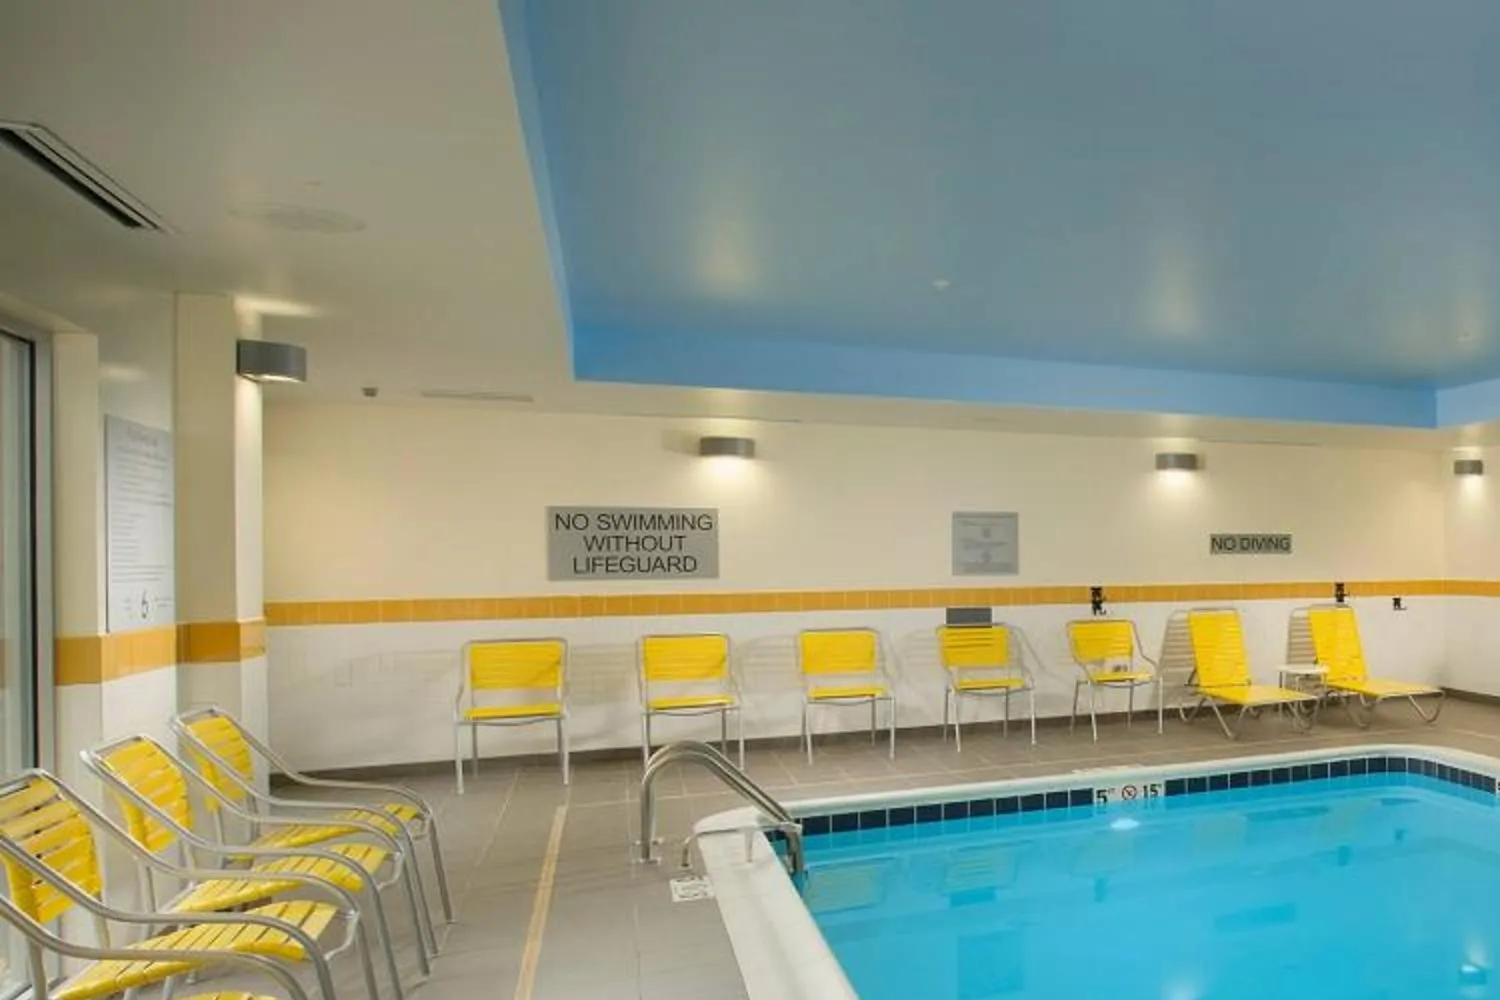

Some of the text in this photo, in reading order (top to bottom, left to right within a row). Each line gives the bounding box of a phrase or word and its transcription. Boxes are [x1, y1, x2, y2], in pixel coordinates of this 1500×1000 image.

[554, 513, 713, 531] NO SWIMMING
[583, 535, 687, 552] WITHOUT
[1211, 537, 1291, 551] NO DIVING
[573, 555, 697, 574] LIFEGUARD
[1096, 789, 1108, 803] 5
